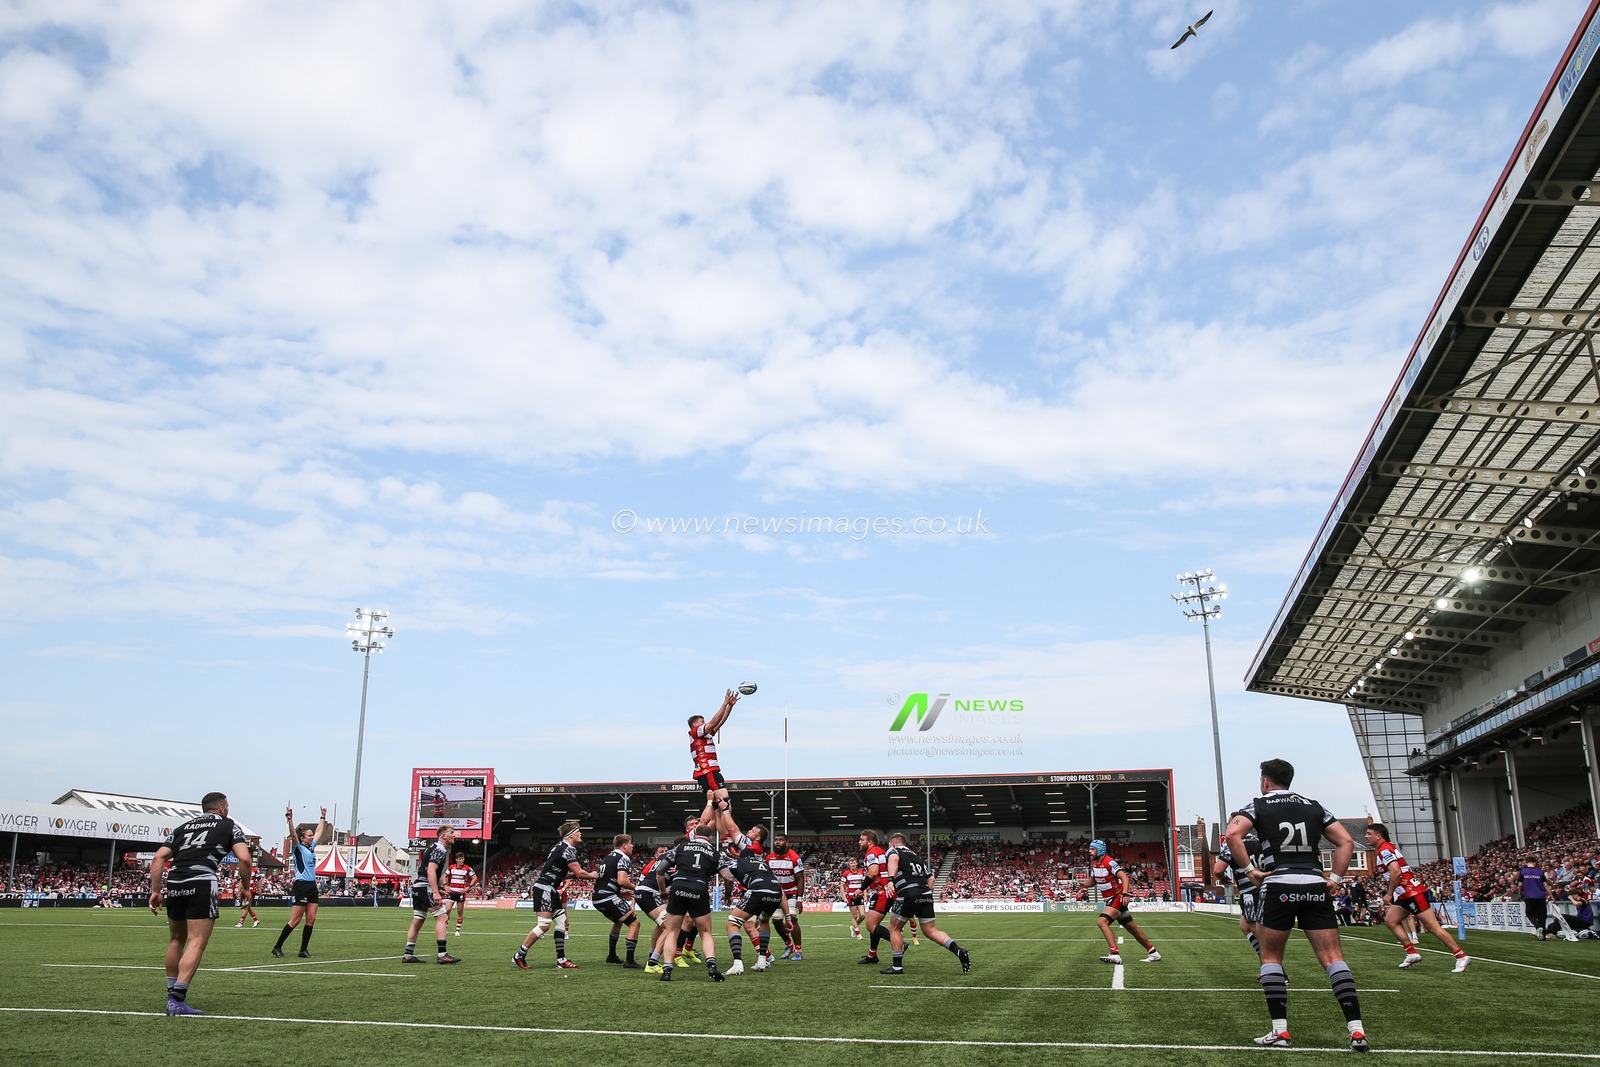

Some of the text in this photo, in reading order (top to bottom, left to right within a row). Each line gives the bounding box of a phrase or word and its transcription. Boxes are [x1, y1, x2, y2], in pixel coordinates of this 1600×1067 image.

[48, 816, 98, 832] VOYAGER
[106, 822, 150, 836] VOYAGER
[184, 821, 218, 830] RADWAN
[48, 828, 97, 838] LOGISTICS
[1278, 822, 1312, 852] 21
[180, 830, 209, 850] 14
[684, 846, 714, 857] BROCKLEBANK
[692, 853, 701, 868] 1
[1250, 854, 1266, 871] 16
[758, 863, 768, 872] 4
[171, 888, 196, 898] Stelrad
[680, 890, 701, 900] Stelrad
[1289, 892, 1325, 902] Stelrad
